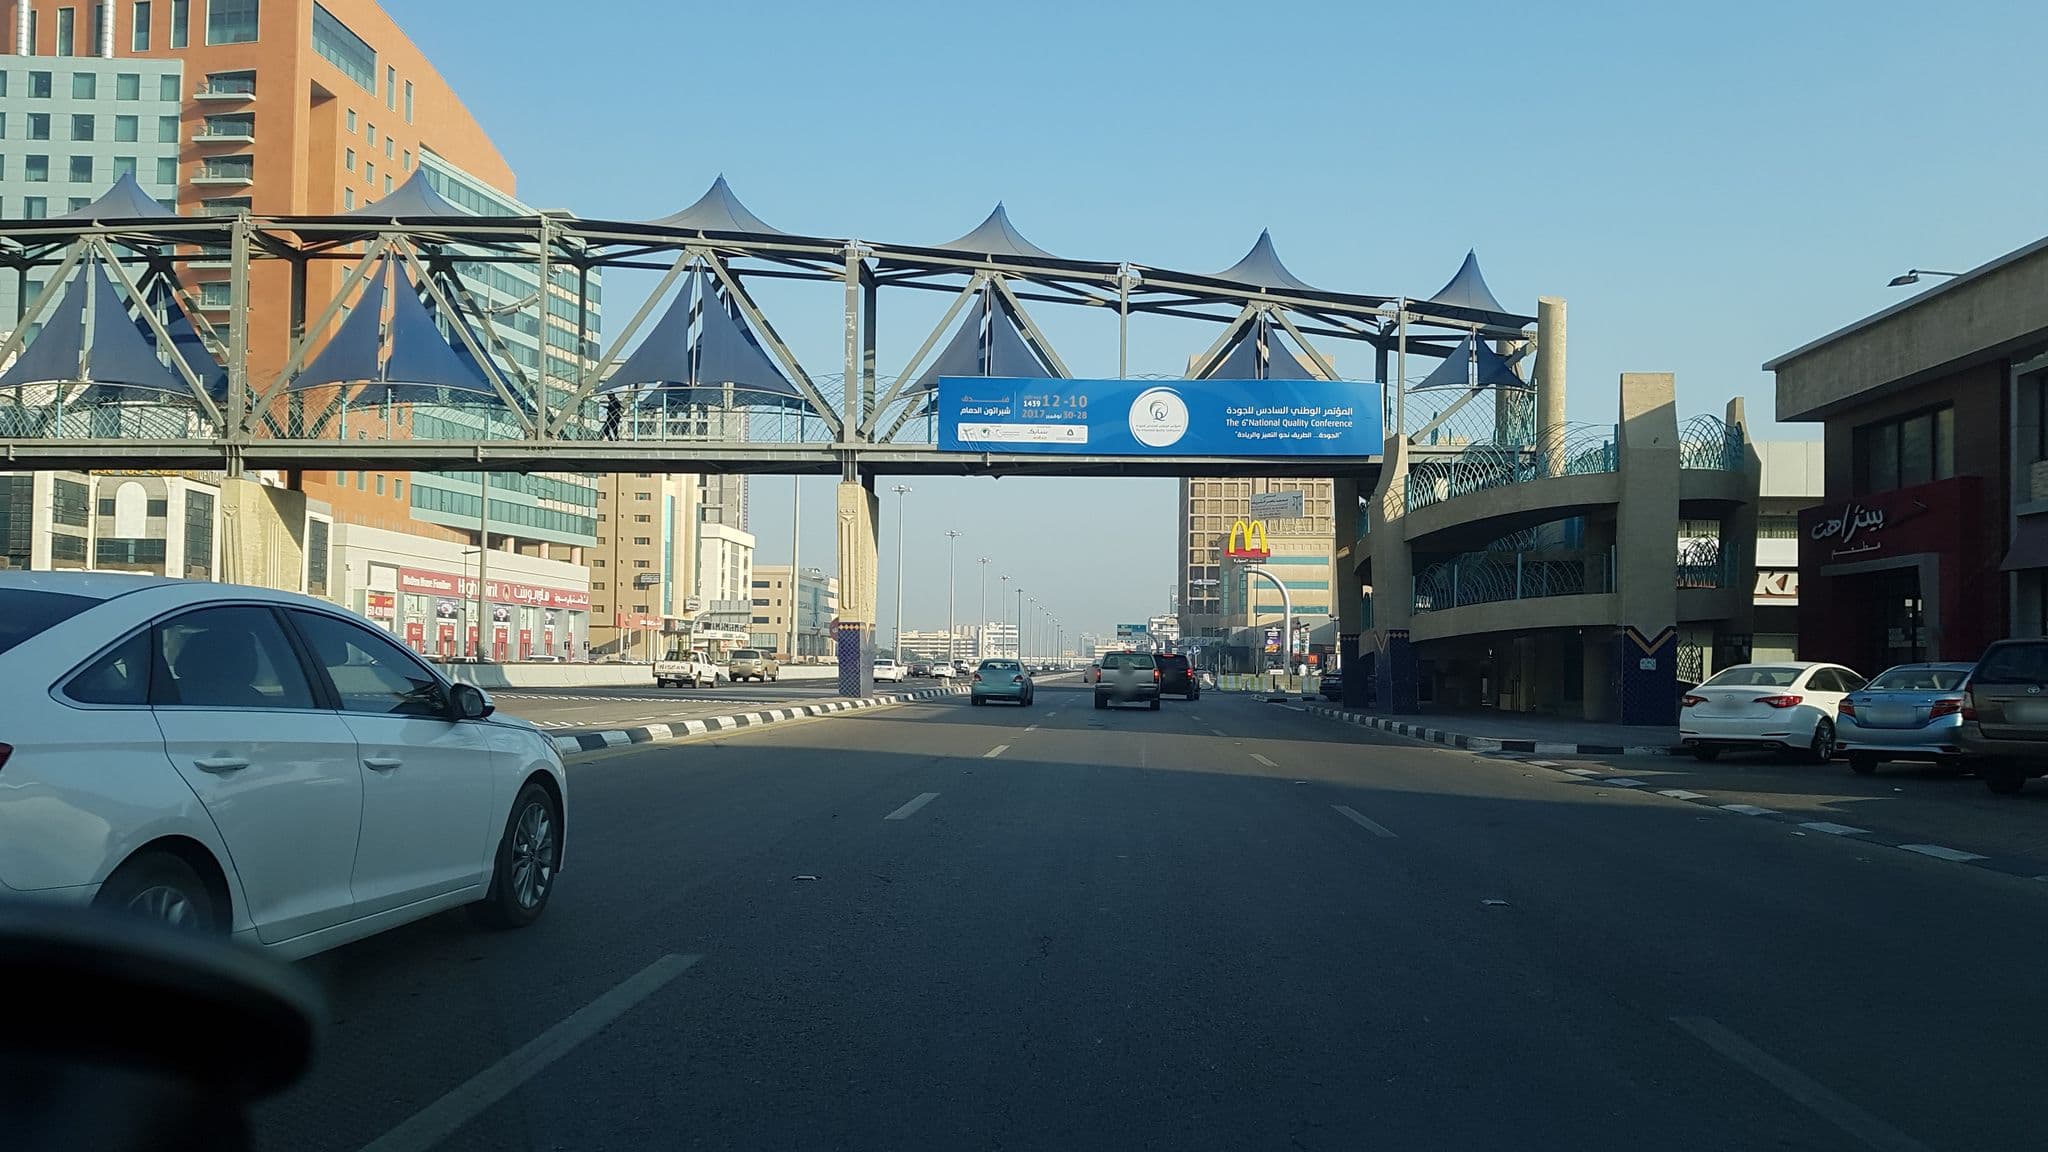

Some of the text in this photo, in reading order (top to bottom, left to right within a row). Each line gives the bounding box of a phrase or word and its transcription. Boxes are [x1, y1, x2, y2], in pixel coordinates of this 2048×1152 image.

[1023, 400, 1041, 408] 1439
[1021, 409, 1045, 419] 2017
[1226, 406, 1353, 418] المؤتمر الوطني السادس للجودة
[1226, 418, 1239, 427] The
[1249, 418, 1281, 427] National
[1282, 418, 1309, 429] Quality
[1311, 418, 1353, 428] Conference
[1278, 432, 1290, 440] نحو
